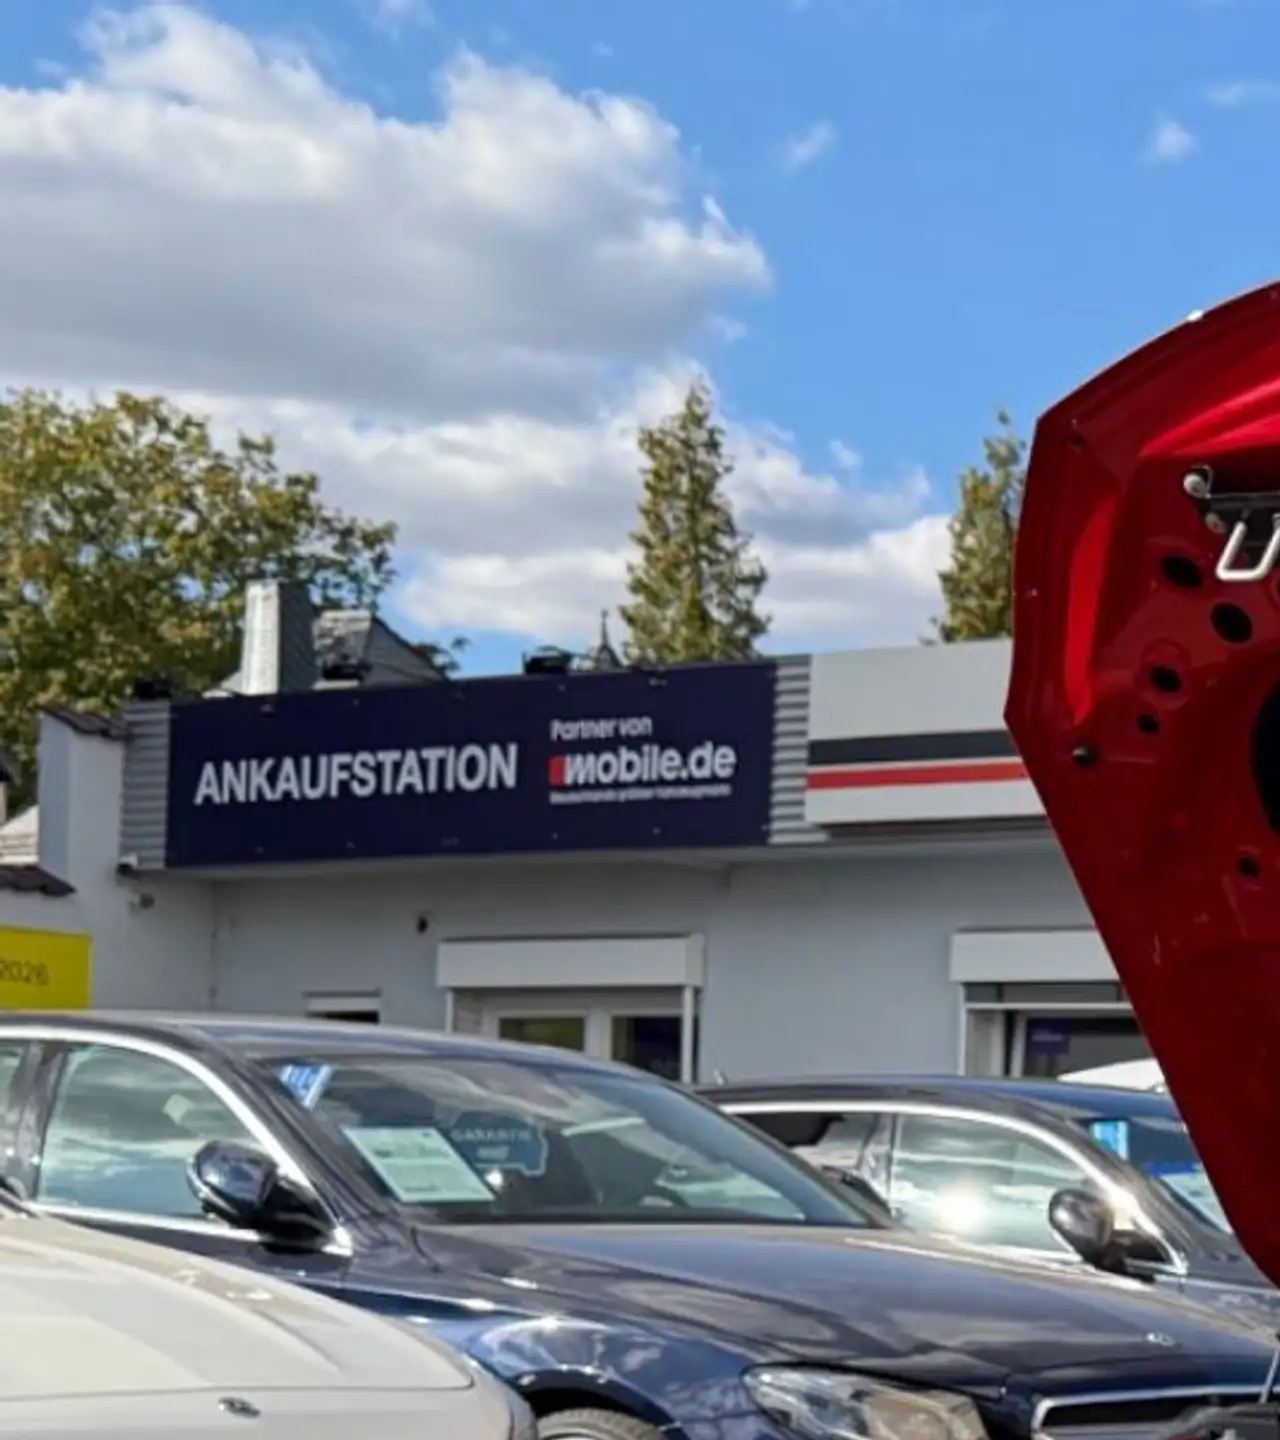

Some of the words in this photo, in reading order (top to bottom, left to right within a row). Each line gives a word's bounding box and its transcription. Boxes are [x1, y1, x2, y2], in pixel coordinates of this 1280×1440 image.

[550, 719, 616, 741] Partner
[618, 716, 652, 736] von
[194, 742, 518, 806] ANKAUFSTATION
[564, 741, 737, 785] mobile.de
